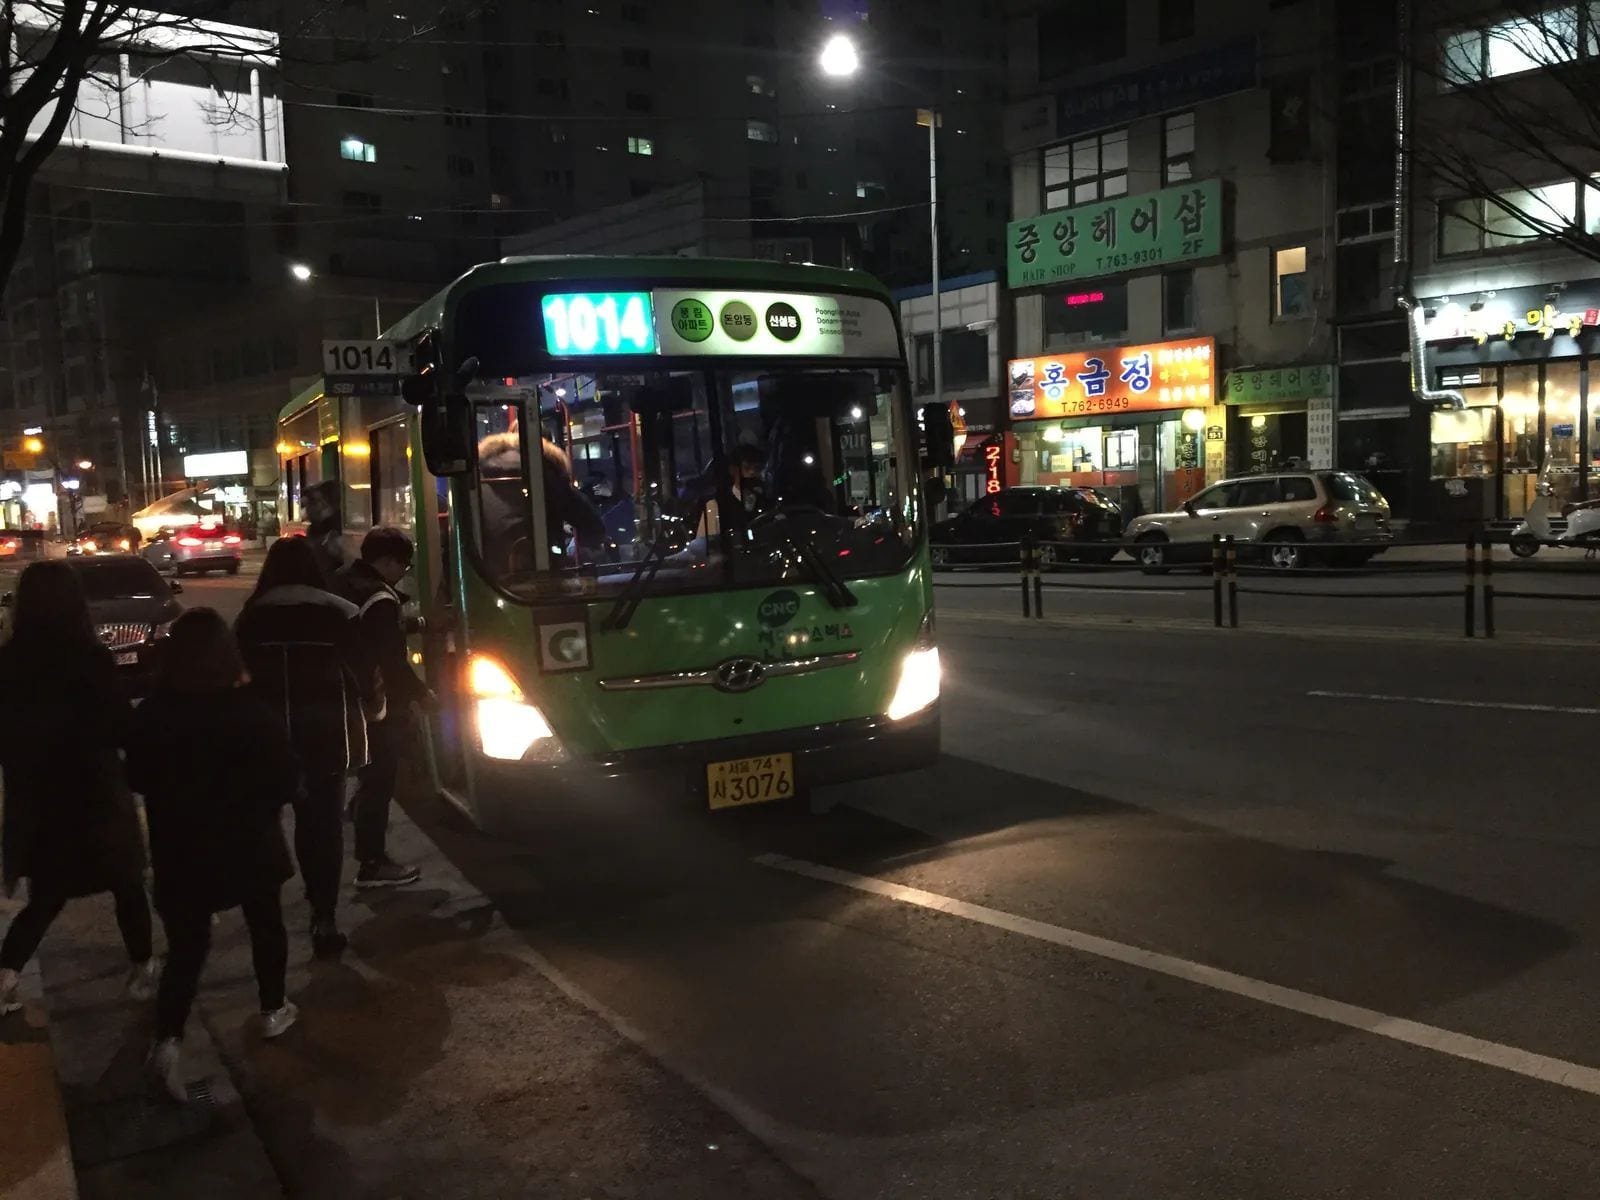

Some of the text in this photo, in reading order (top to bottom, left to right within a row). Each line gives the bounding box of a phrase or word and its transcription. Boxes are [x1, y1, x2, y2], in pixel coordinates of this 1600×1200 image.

[1015, 189, 1207, 264] 중앙헤어샵
[1182, 239, 1204, 255] 2F
[1096, 248, 1163, 270] T.763-9301
[1022, 268, 1046, 281] HAIR
[546, 296, 649, 350] 1014
[678, 318, 708, 331] 아파트
[724, 314, 752, 326] 돈암동
[769, 315, 798, 328] 신설동
[328, 345, 393, 370] 1014
[1039, 353, 1153, 398] 홍금정
[1062, 397, 1129, 413] T.762-6949
[761, 601, 797, 617] CNG
[729, 757, 772, 775] 서울 74
